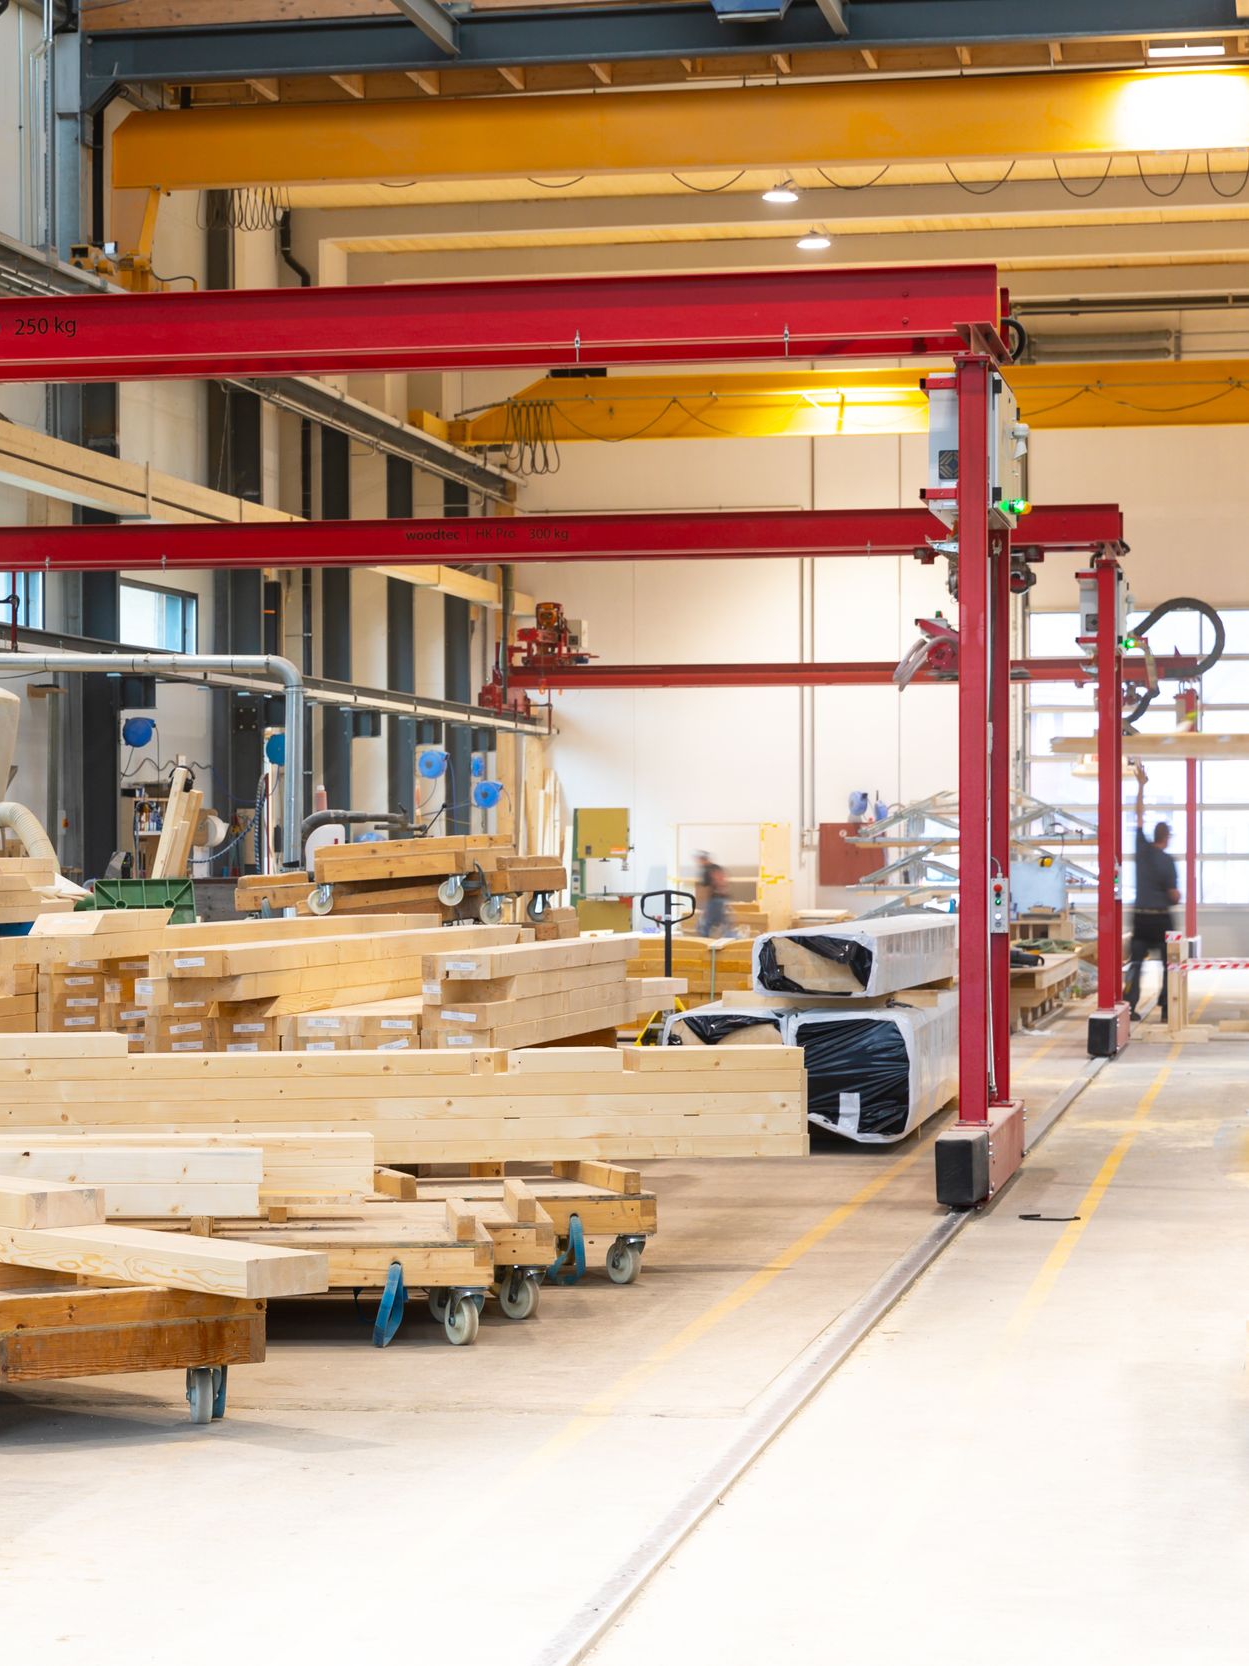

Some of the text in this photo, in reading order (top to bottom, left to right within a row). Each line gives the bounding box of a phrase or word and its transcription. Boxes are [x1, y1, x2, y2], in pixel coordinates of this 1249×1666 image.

[14, 318, 49, 336] 250
[54, 316, 77, 338] kg
[405, 528, 460, 541] woodtec
[475, 528, 492, 540] HK
[496, 527, 516, 540] Pro
[553, 527, 569, 541] kg
